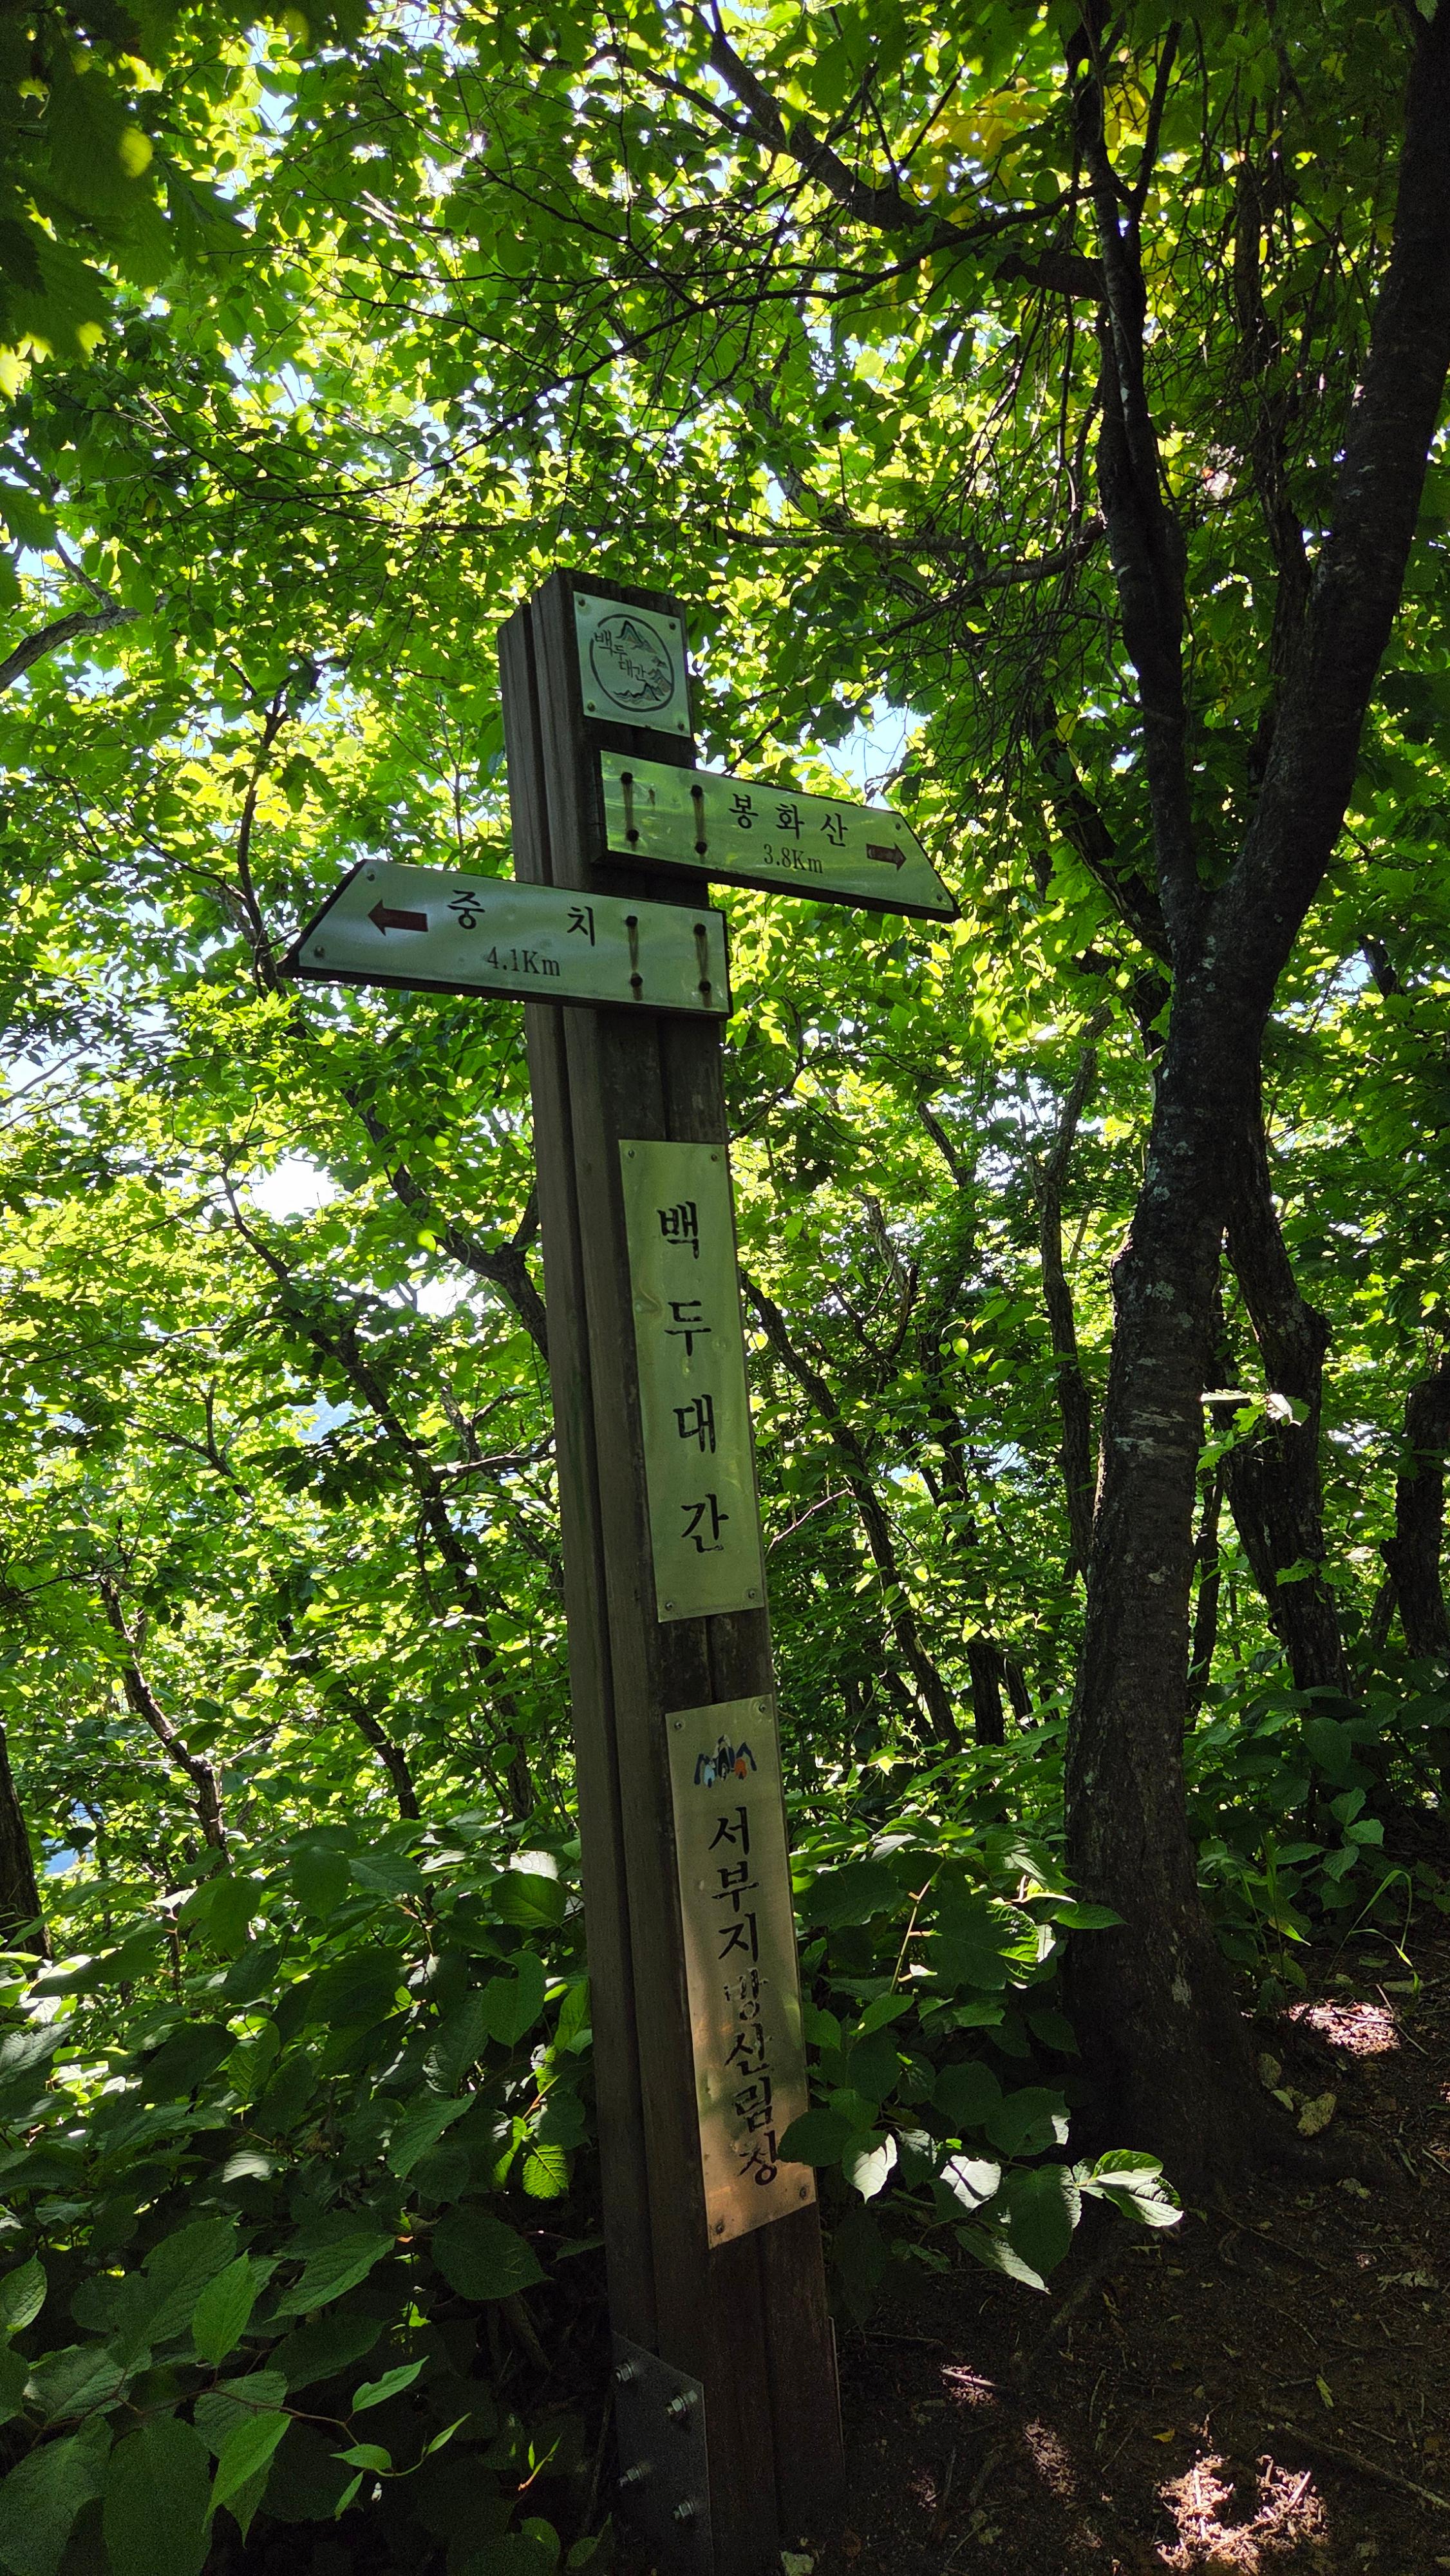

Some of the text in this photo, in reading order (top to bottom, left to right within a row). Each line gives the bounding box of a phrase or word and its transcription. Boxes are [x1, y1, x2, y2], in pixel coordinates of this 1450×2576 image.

[729, 793, 849, 847] 봉화산
[764, 844, 824, 875] 3.8Km
[487, 947, 561, 977] 4.1Km
[657, 1200, 730, 1553] 백두대간
